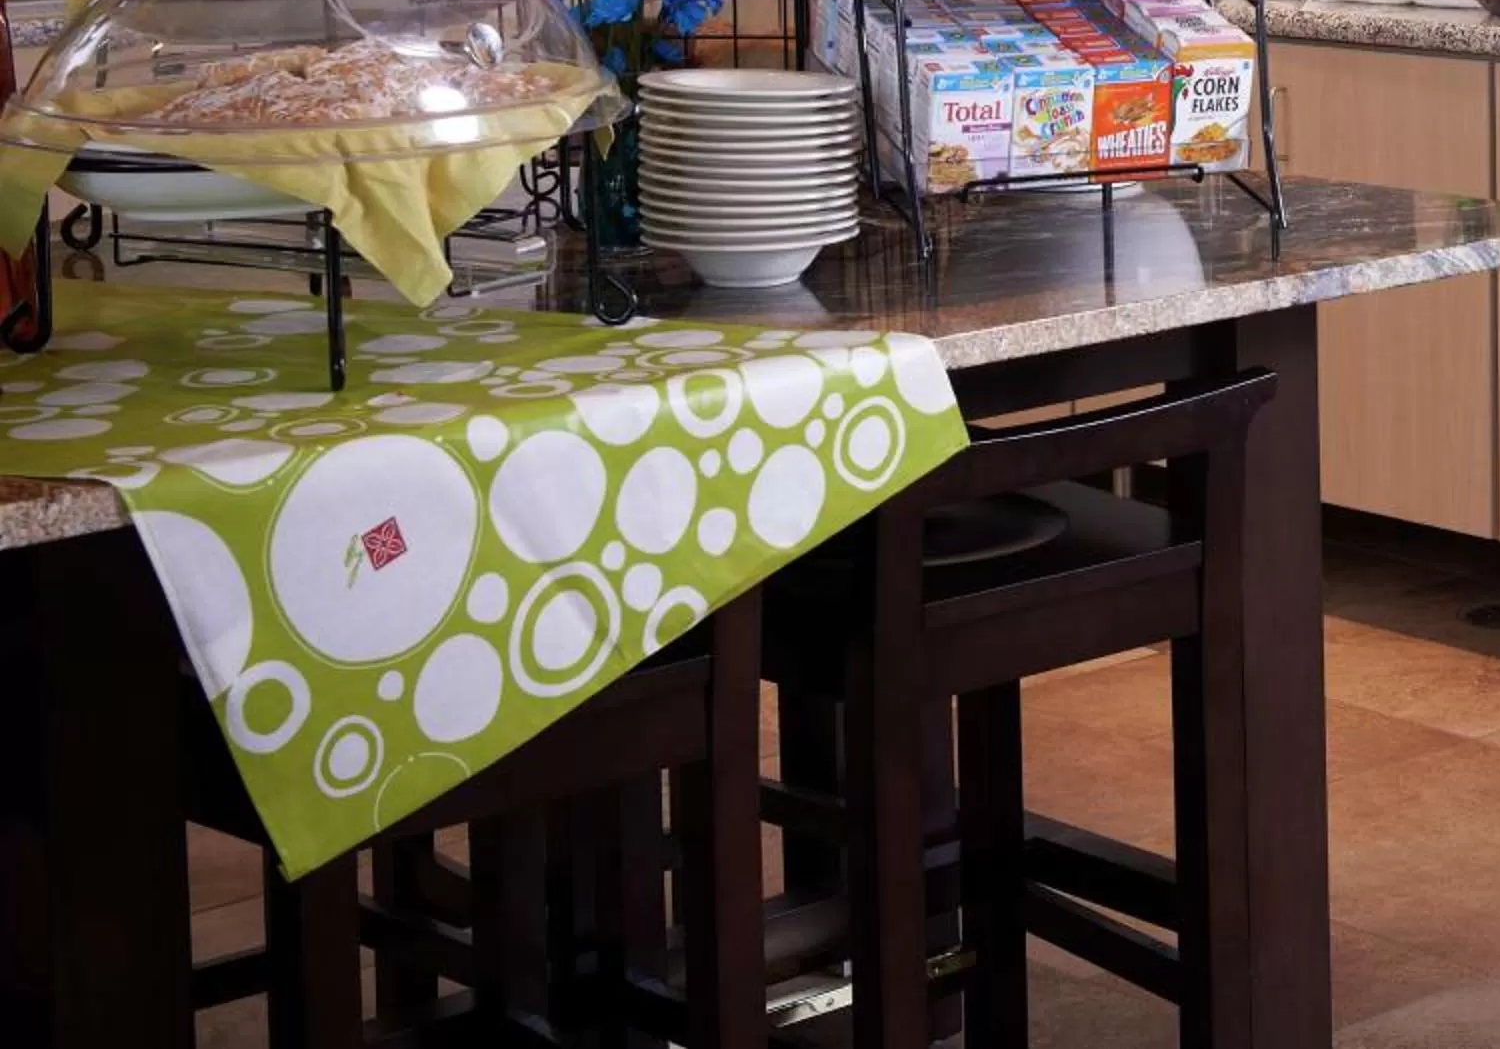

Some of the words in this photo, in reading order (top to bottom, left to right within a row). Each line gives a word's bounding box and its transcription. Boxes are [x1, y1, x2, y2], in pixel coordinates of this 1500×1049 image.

[1193, 75, 1241, 96] CORN
[943, 100, 1002, 123] Total
[1191, 96, 1240, 114] FLAKES
[1097, 120, 1167, 160] WHEATIES
